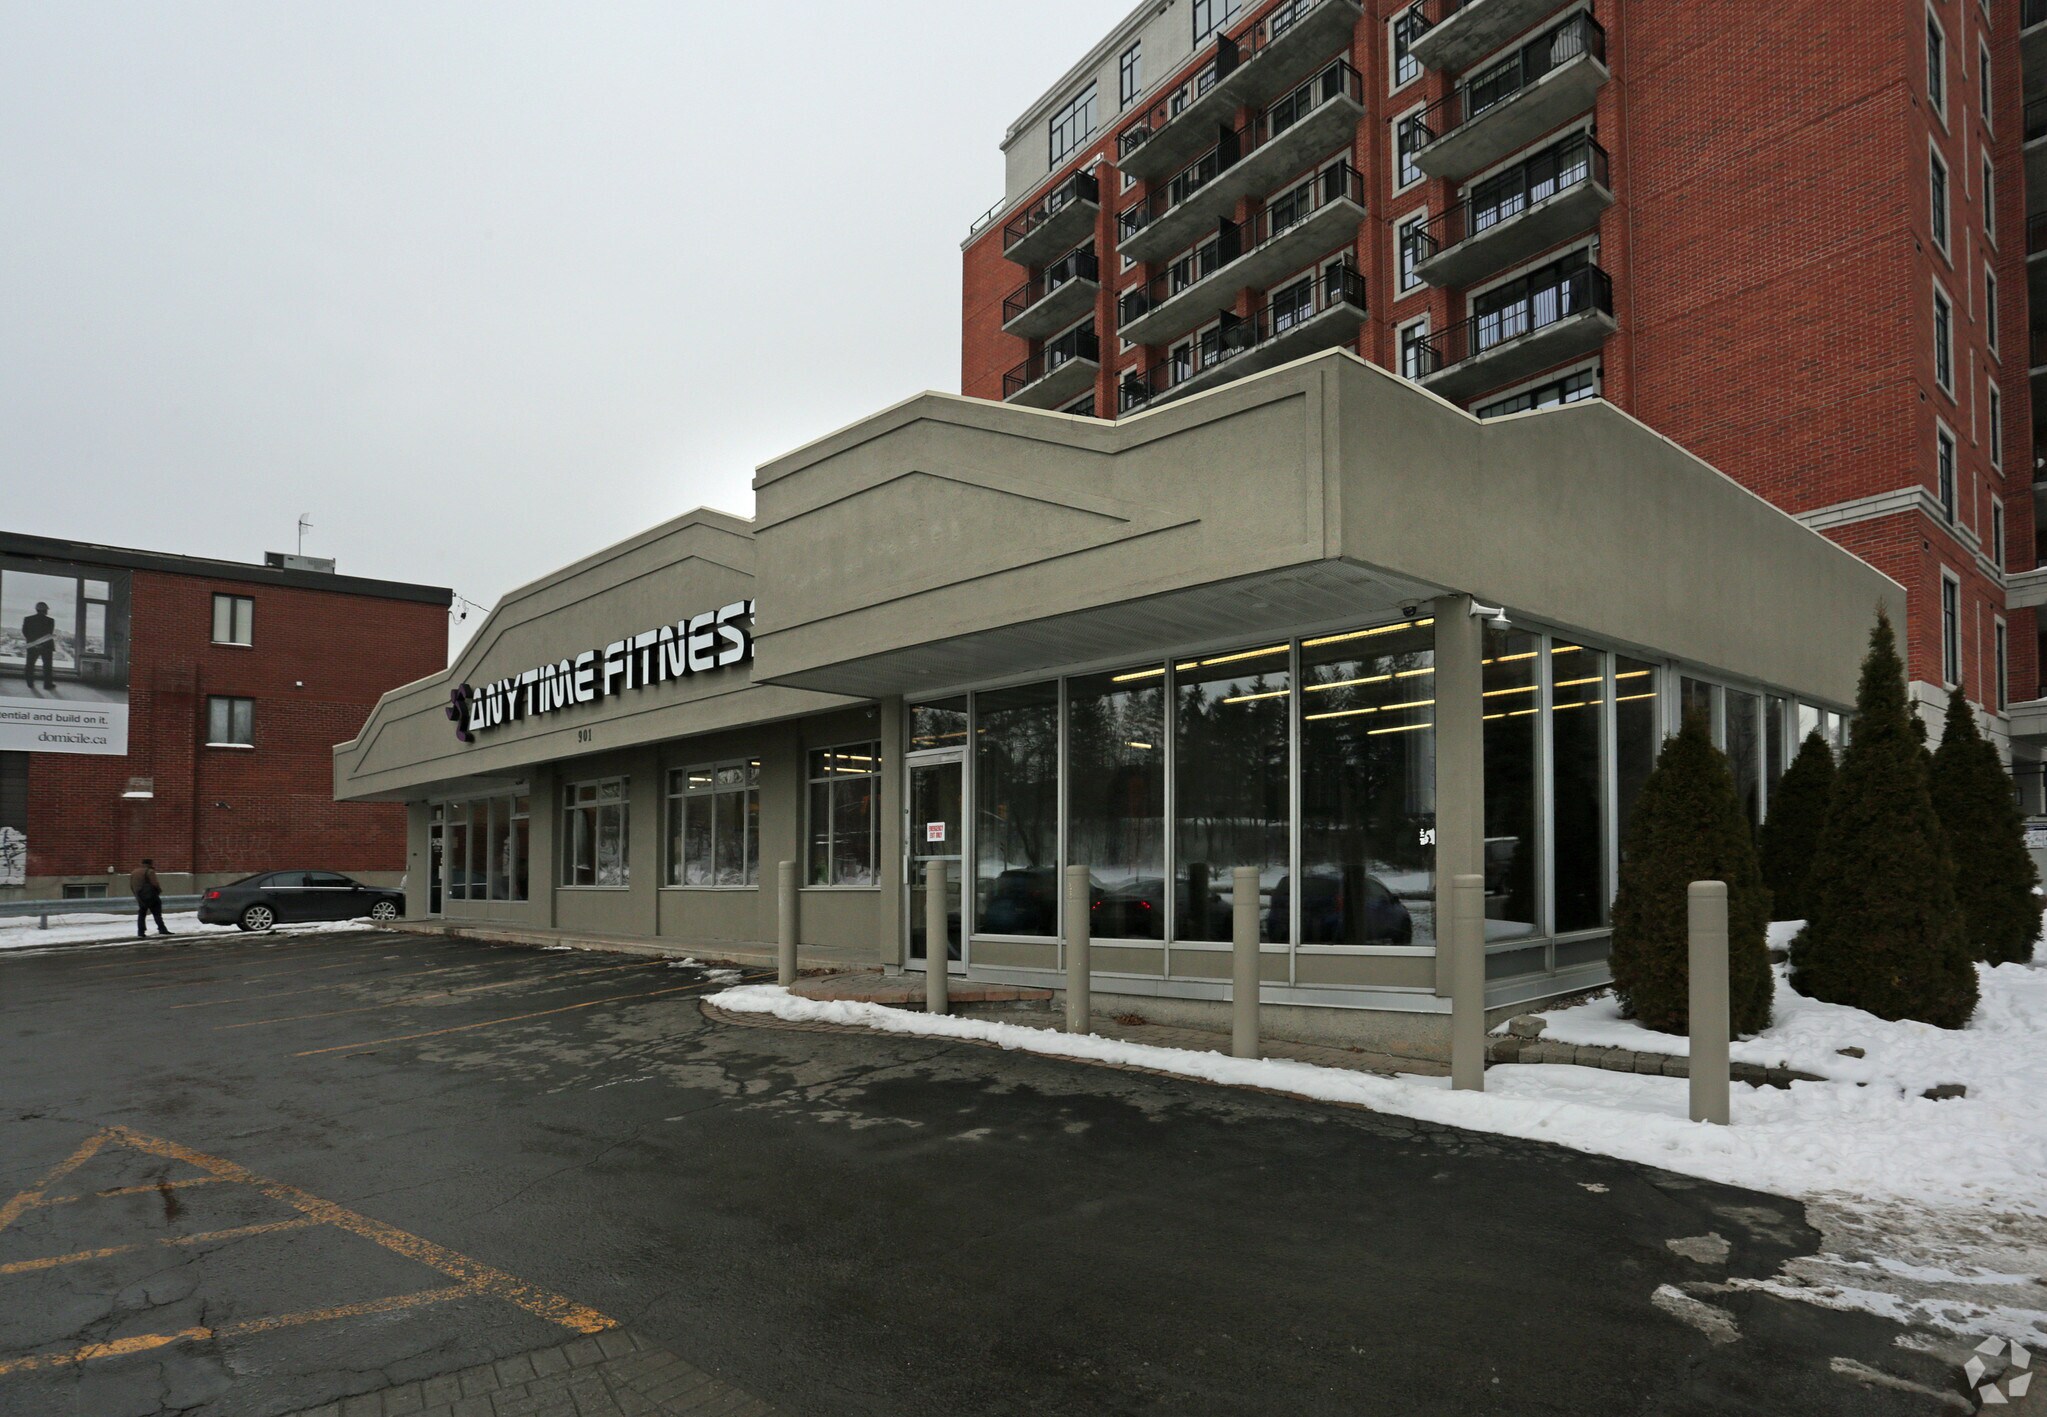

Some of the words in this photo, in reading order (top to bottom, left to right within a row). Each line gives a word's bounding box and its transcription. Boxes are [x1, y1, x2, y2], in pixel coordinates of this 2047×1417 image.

[469, 649, 595, 731] ANYTIME
[604, 597, 755, 696] FITNES
[33, 713, 52, 721] and
[56, 713, 80, 723] build
[98, 716, 108, 725] it.
[38, 731, 107, 745] domicile.ca
[578, 728, 591, 743] 901
